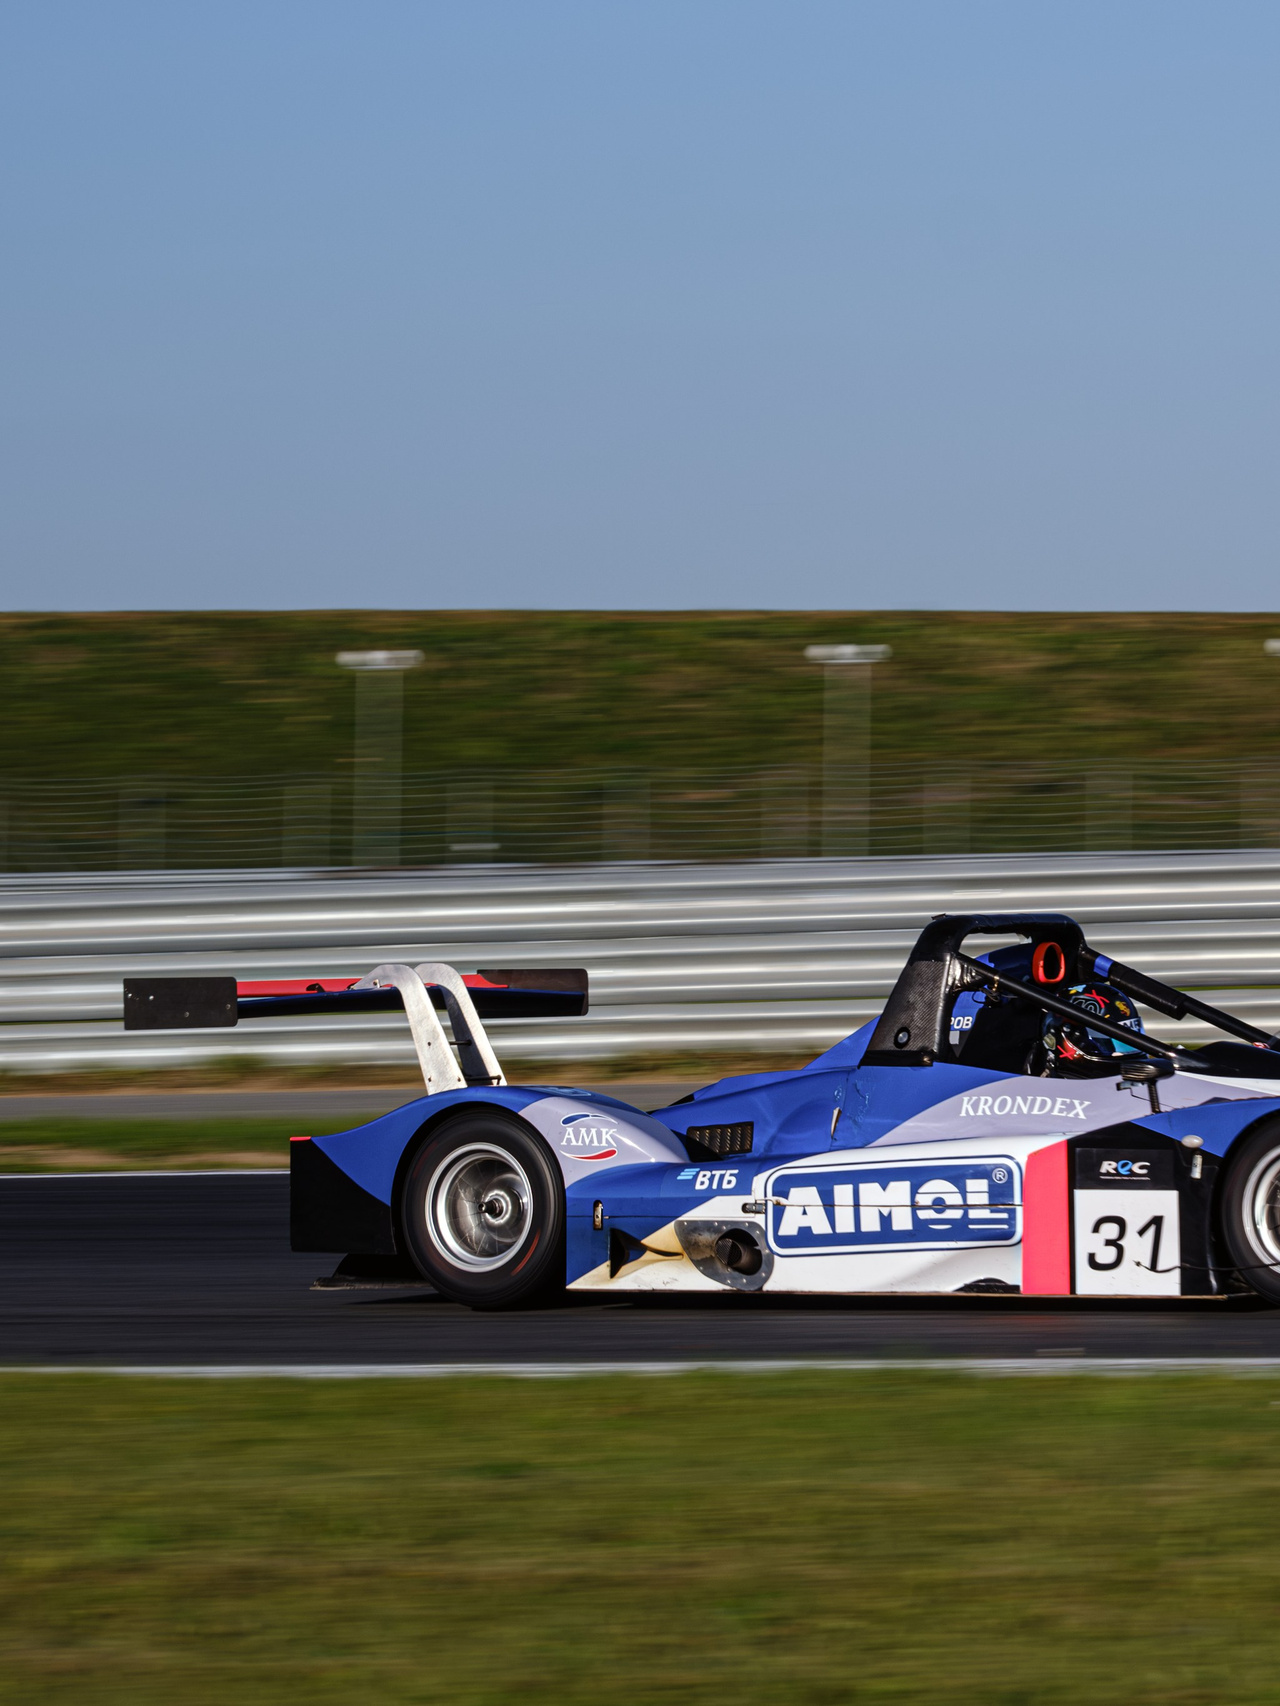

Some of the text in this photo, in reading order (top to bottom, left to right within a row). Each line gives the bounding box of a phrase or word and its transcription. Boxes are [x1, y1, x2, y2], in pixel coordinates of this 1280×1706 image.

[959, 1096, 1091, 1120] KRONDEX
[694, 1169, 740, 1191] ВТБ
[1087, 1214, 1164, 1272] 31
